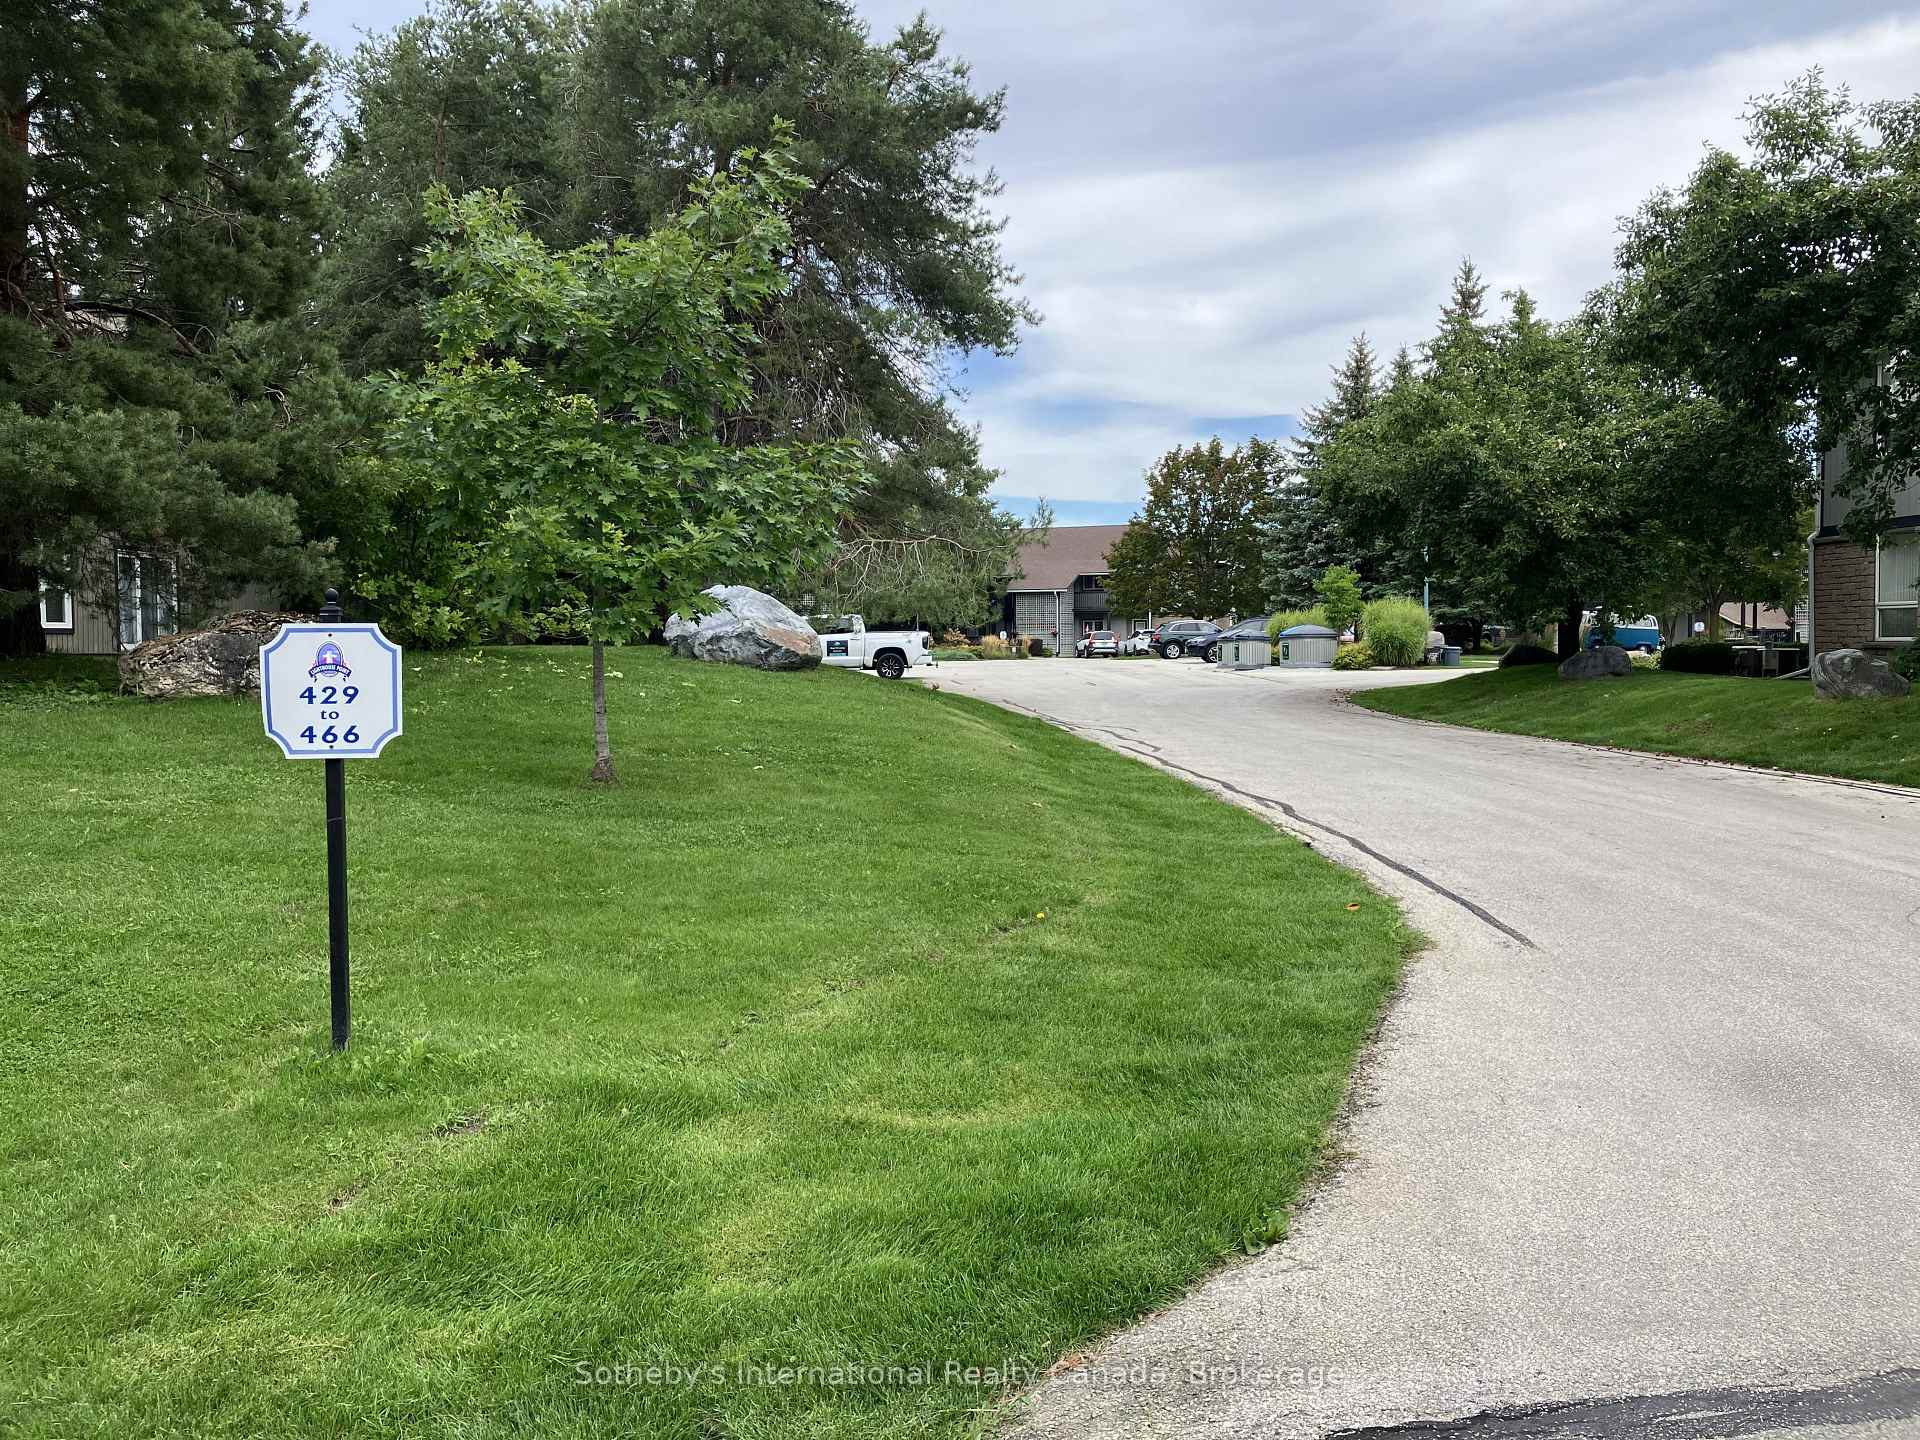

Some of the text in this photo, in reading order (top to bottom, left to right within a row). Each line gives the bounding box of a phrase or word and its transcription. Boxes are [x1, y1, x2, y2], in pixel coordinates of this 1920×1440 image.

[299, 686, 360, 704] 429
[320, 710, 340, 720] to
[300, 725, 360, 744] 466
